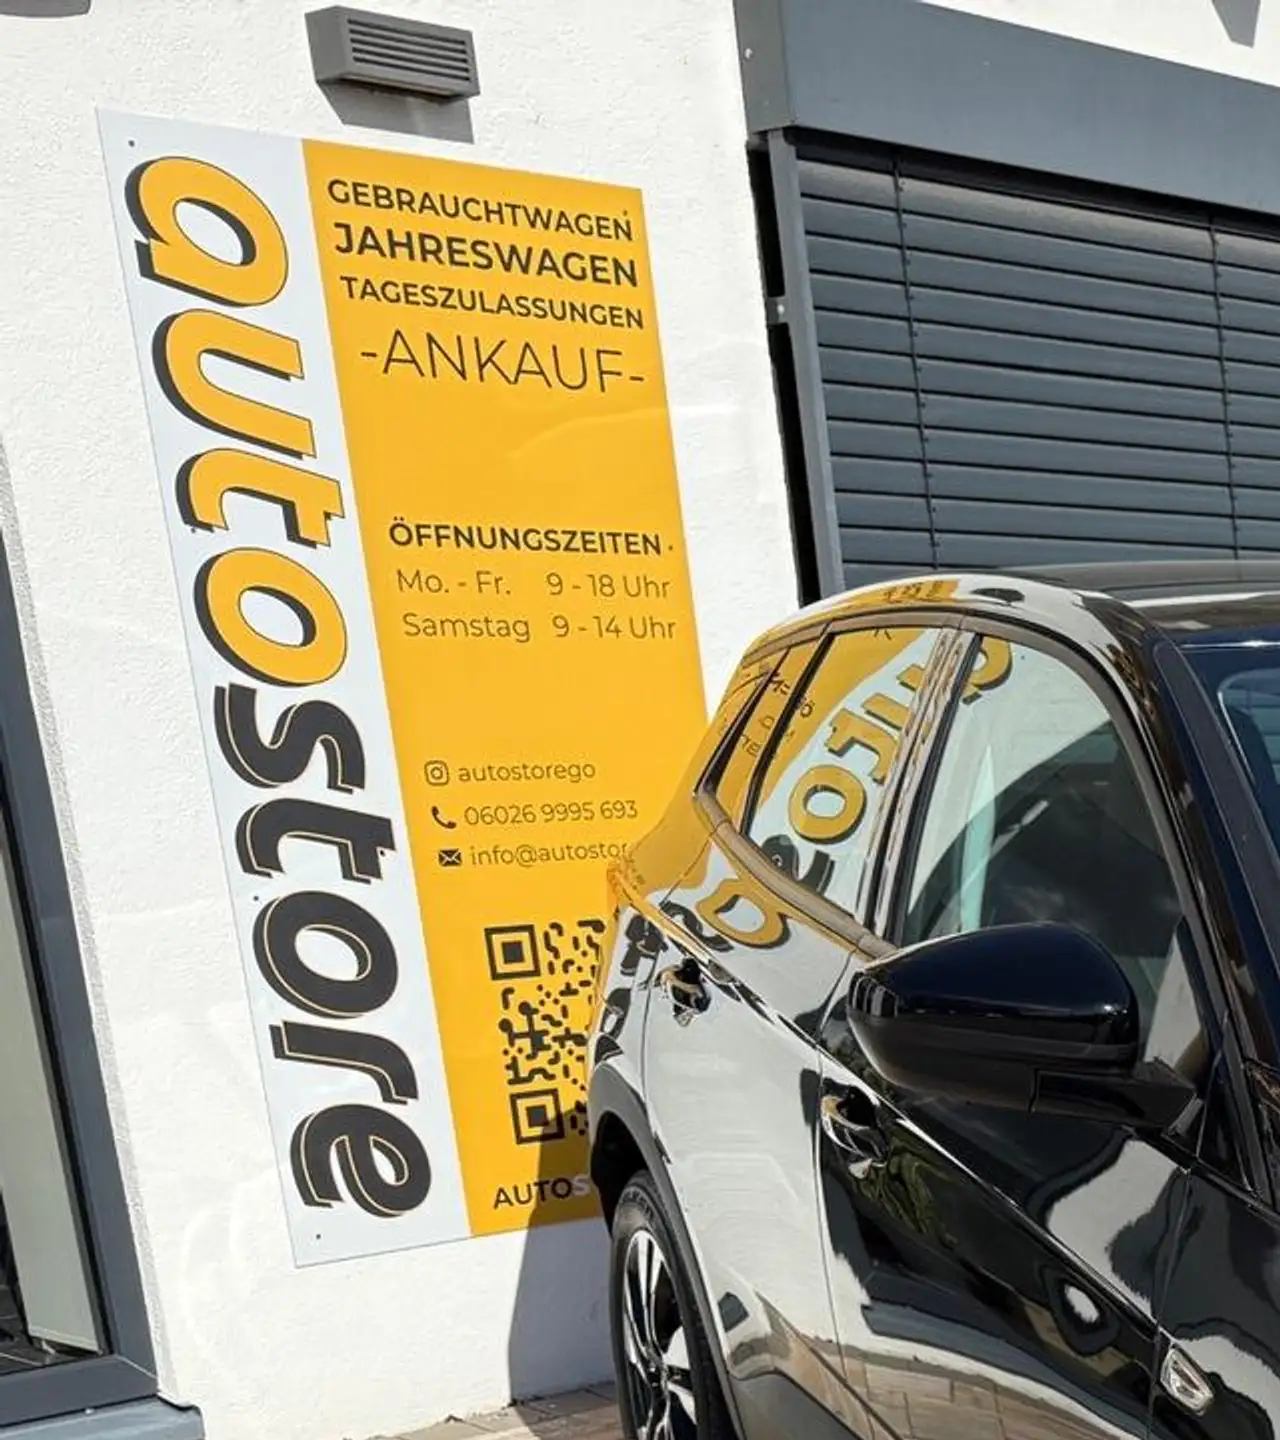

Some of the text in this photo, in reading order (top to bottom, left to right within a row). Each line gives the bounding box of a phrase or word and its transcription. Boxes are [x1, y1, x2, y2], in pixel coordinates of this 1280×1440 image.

[328, 179, 633, 241] GEBRAUCHTWAGEN
[333, 222, 638, 287] JAHRESWAGEN
[340, 275, 644, 329] TAGESZULASSUNGEN
[389, 516, 661, 555] ÖFFNUNGSZEITEN
[396, 569, 450, 594] Mo.
[476, 570, 511, 595] Fr.
[624, 574, 672, 598] Uhr
[403, 612, 531, 643] Samstag
[629, 616, 677, 639] Uhr
[124, 155, 432, 1218] autostore
[458, 763, 596, 783] autostorego
[464, 800, 638, 826] 06026 9995 693
